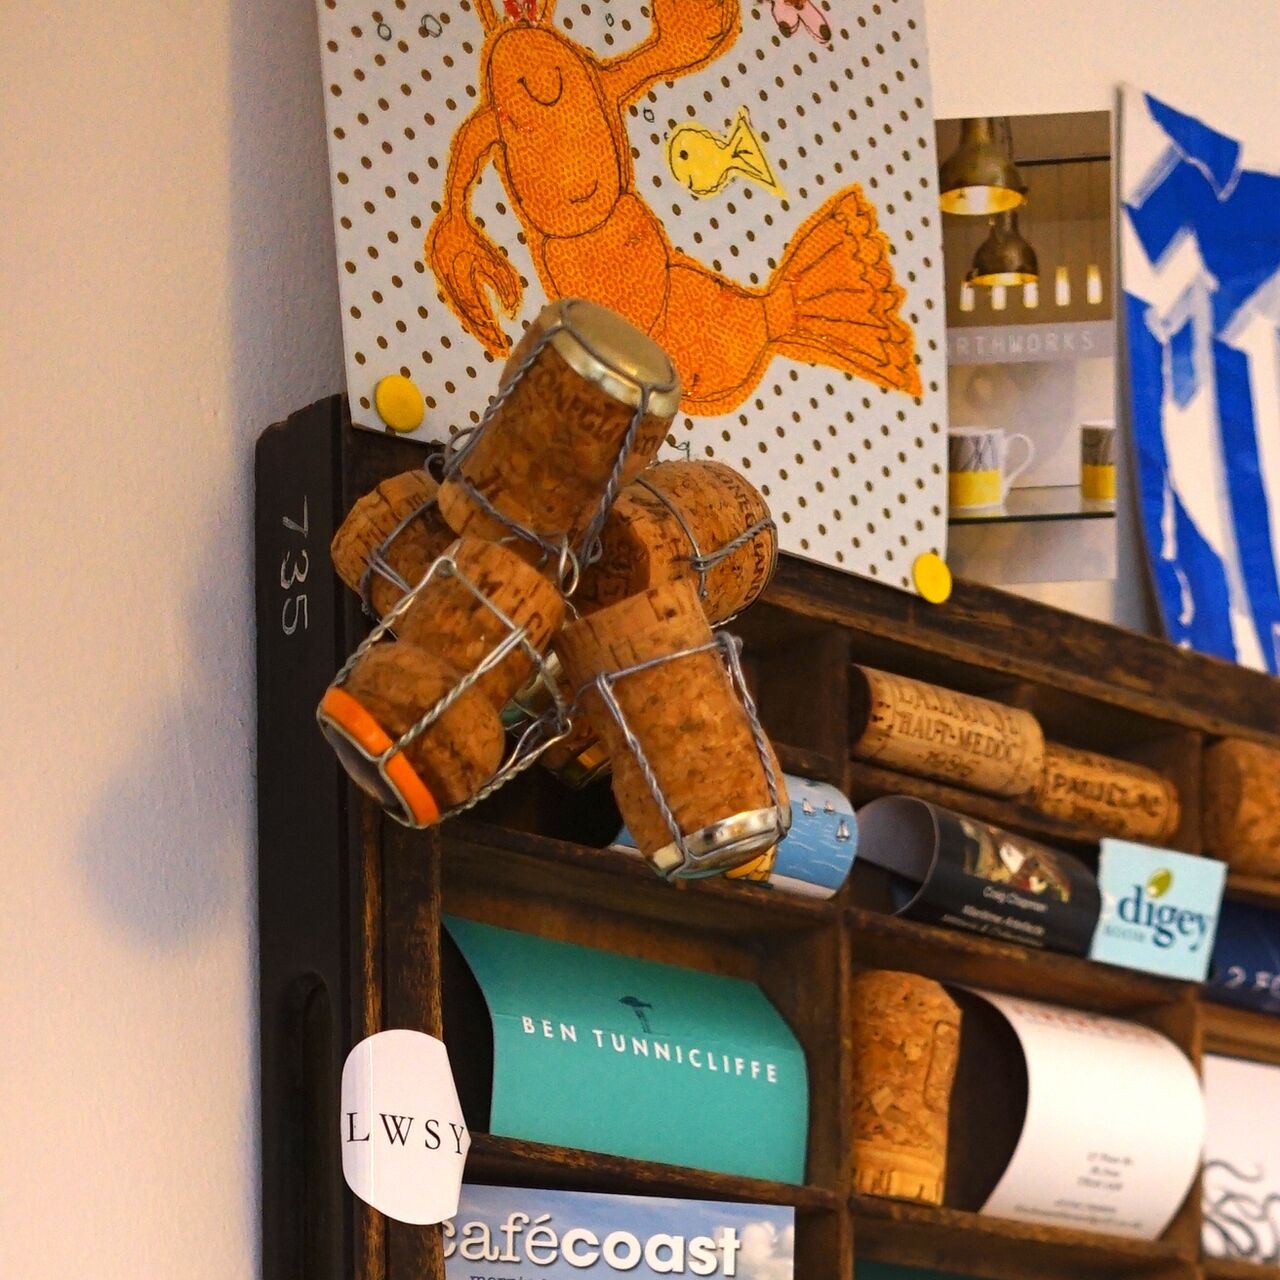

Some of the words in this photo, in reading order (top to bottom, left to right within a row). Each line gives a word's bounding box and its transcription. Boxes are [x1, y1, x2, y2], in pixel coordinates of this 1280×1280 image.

[954, 331, 1094, 355] RTHWORKS
[279, 495, 310, 636] 735
[1118, 885, 1209, 951] digey
[1227, 965, 1246, 990] 2
[521, 1016, 579, 1043] BEN
[592, 1029, 778, 1083] TUNNICLIFFE
